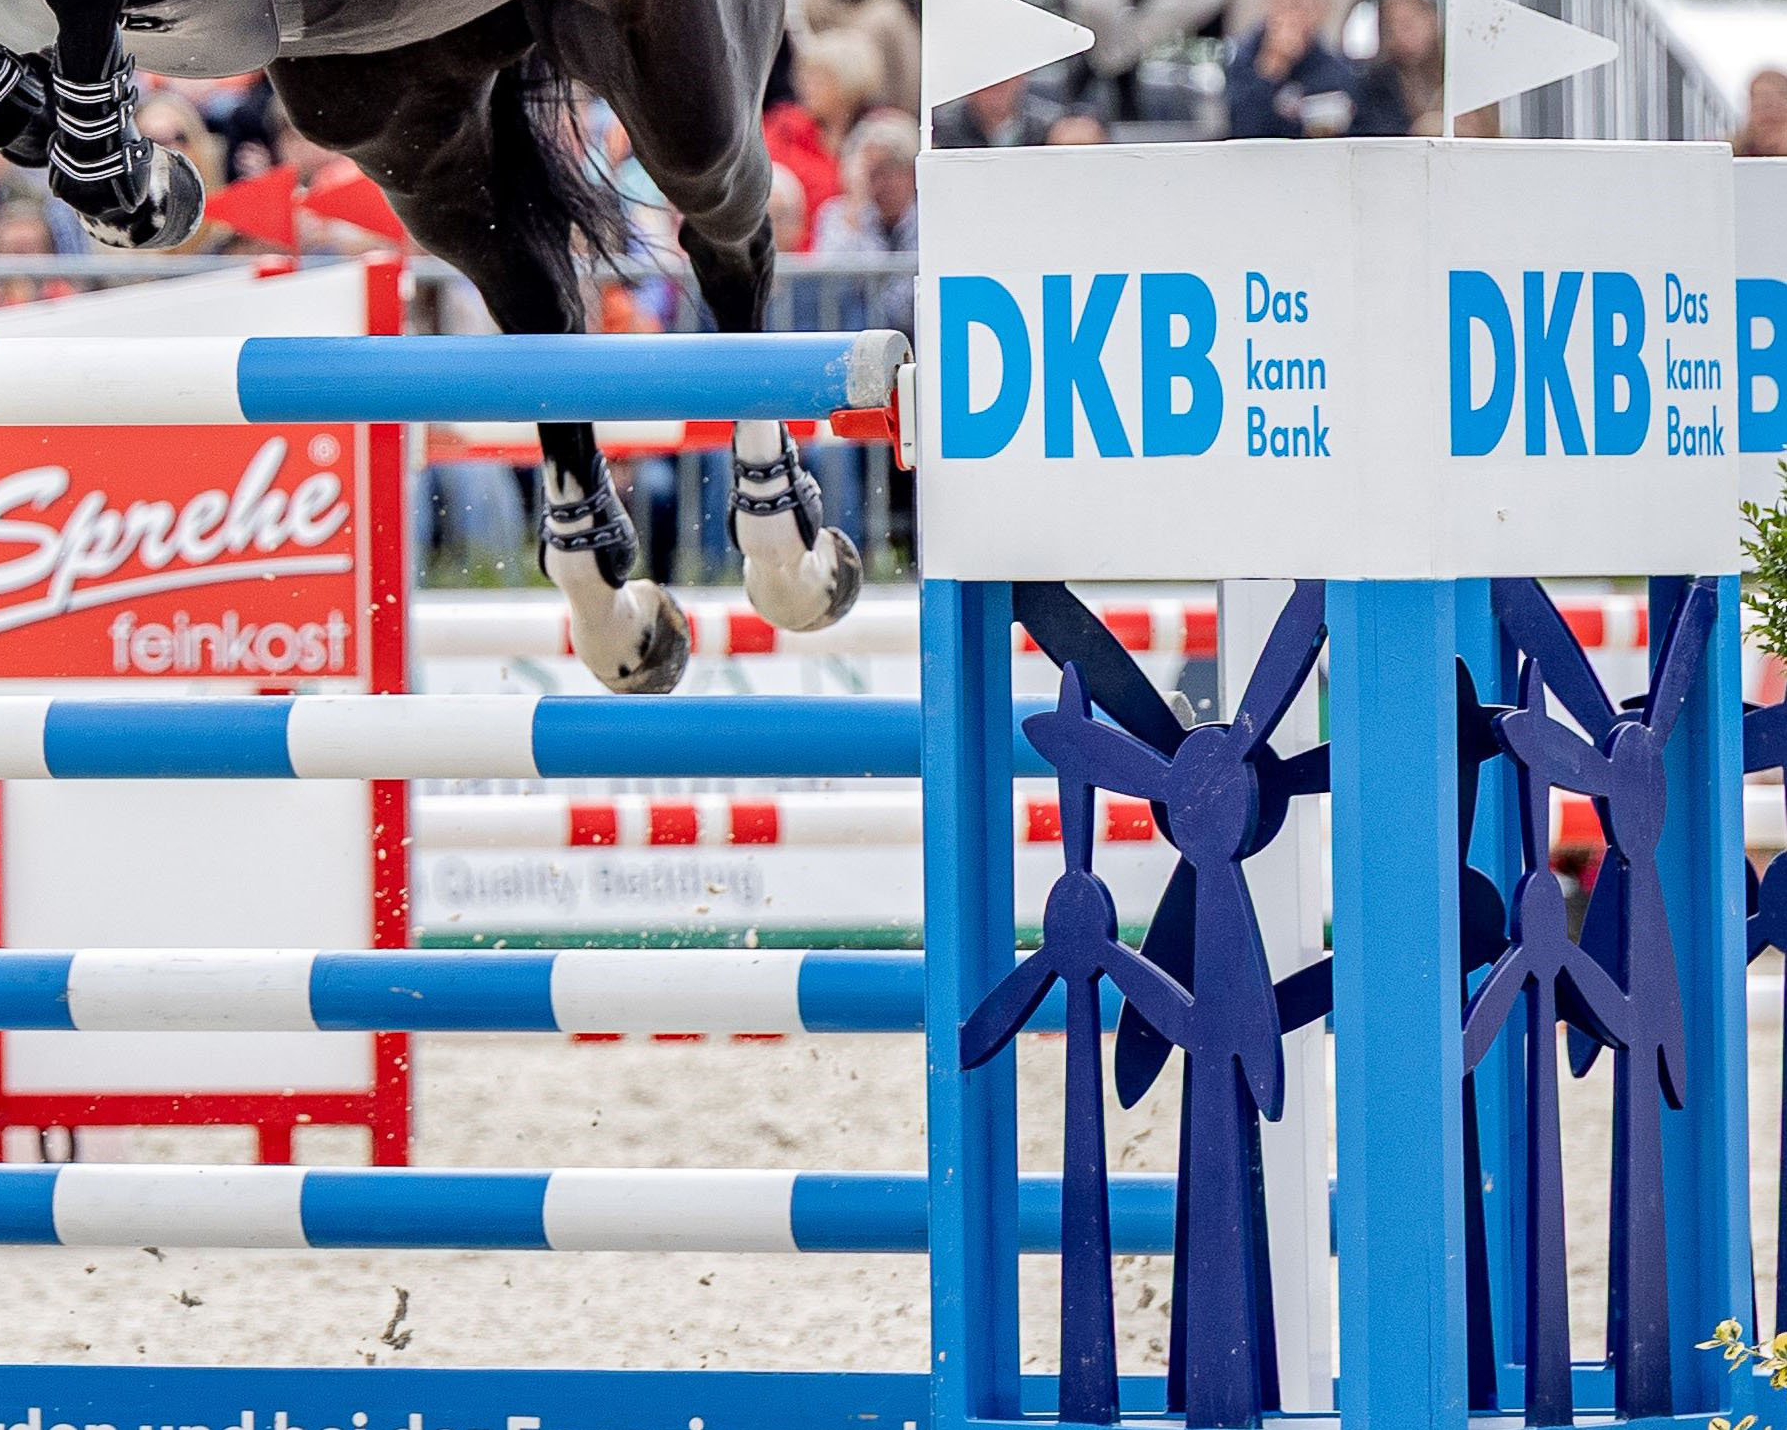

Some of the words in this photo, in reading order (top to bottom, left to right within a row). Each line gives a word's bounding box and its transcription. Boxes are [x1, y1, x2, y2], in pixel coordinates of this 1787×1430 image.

[1246, 271, 1309, 324] Das
[1665, 273, 1710, 325] Das
[939, 272, 1224, 459] DKB
[1246, 338, 1327, 391] kann
[1449, 270, 1652, 457] DKB
[1665, 338, 1723, 391] kann
[1248, 405, 1331, 459] Bank
[1667, 405, 1726, 457] Bank
[109, 609, 351, 674] feinkost
